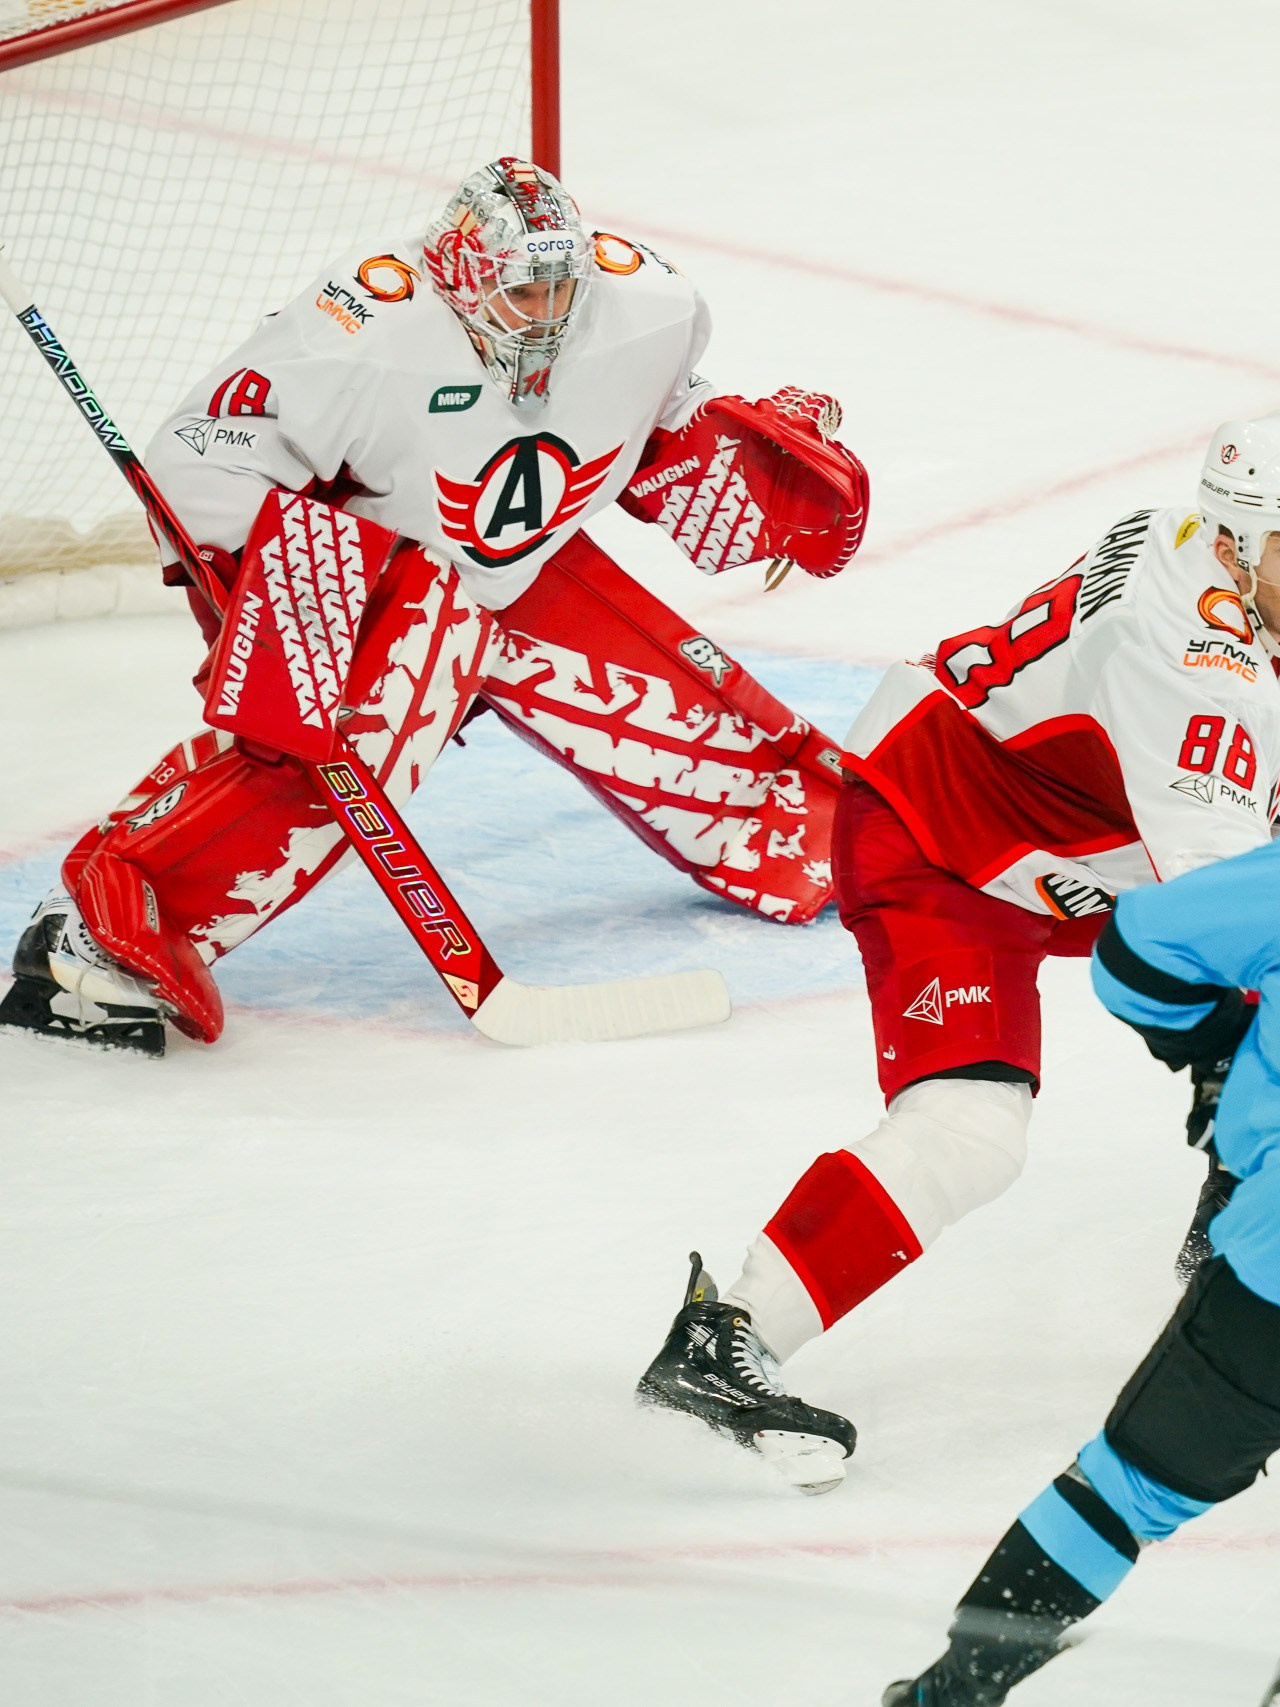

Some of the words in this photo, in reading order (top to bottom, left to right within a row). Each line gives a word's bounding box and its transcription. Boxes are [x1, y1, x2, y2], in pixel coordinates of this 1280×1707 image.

[321, 280, 375, 326] УГМК
[207, 367, 272, 418] 18
[628, 456, 702, 499] VAUGHN
[216, 590, 264, 716] VAUGHN
[1186, 639, 1260, 673] УГМК
[150, 761, 176, 786] 18
[1177, 714, 1258, 791] 88
[1046, 873, 1113, 918] WIN
